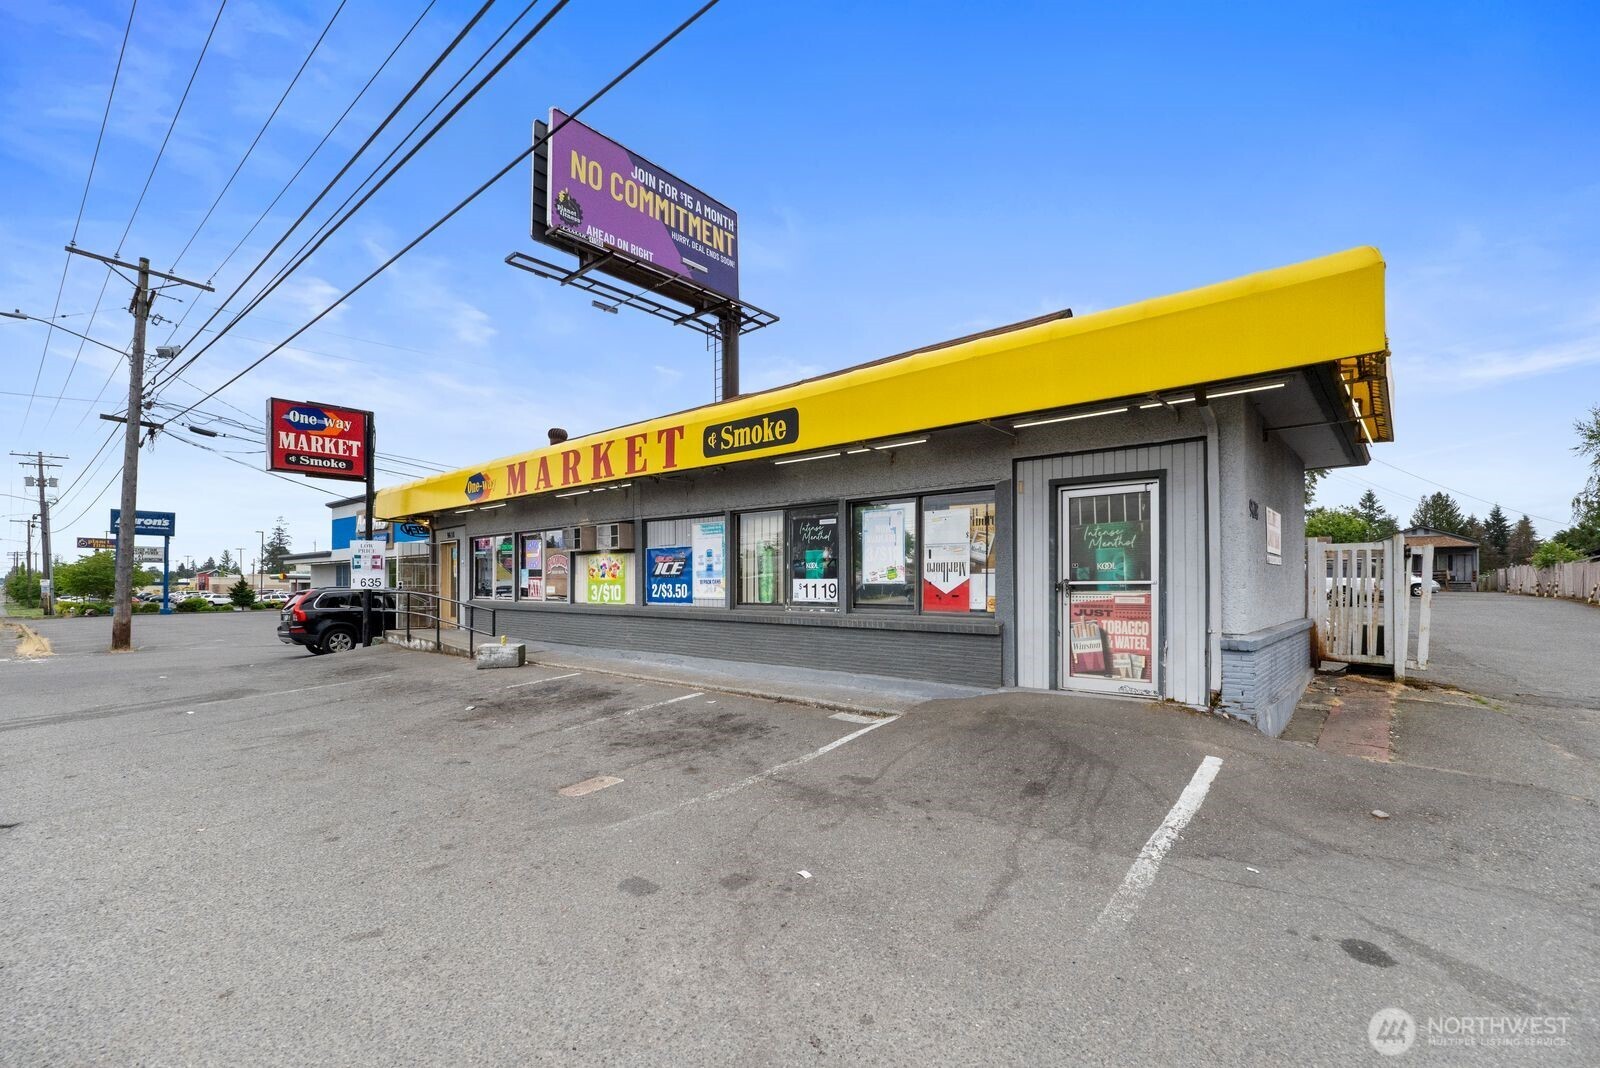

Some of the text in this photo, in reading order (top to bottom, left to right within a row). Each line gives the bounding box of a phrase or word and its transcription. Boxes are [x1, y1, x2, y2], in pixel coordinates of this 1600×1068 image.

[571, 149, 735, 257] NO COMMITMENT
[630, 166, 735, 232] JOIN FOR $15 A MONTH
[586, 224, 616, 247] AHEAD
[617, 238, 630, 252] ON
[630, 243, 655, 262] RIGHT
[671, 231, 692, 248] HURRY,
[692, 240, 706, 255] DEAL
[706, 248, 720, 261] ENDS
[708, 417, 787, 449] & Smoke
[278, 431, 361, 457] MARKET
[300, 455, 347, 468] Smoke
[506, 425, 685, 496] MARKET
[802, 530, 832, 543] Menthol
[1084, 525, 1124, 540] Intense
[1088, 534, 1137, 550] Menthol
[653, 562, 685, 576] ICE
[926, 562, 967, 583] Marlboro
[1096, 562, 1117, 570] KOOL
[360, 578, 382, 588] 635
[652, 583, 688, 599] 2/$3.50
[591, 583, 621, 602] 3/$10
[799, 583, 837, 600] $11.19
[1074, 609, 1114, 617] JUST
[1101, 620, 1149, 635] TOBACCO
[1073, 641, 1101, 651] Winston
[1114, 636, 1150, 651] WATER.
